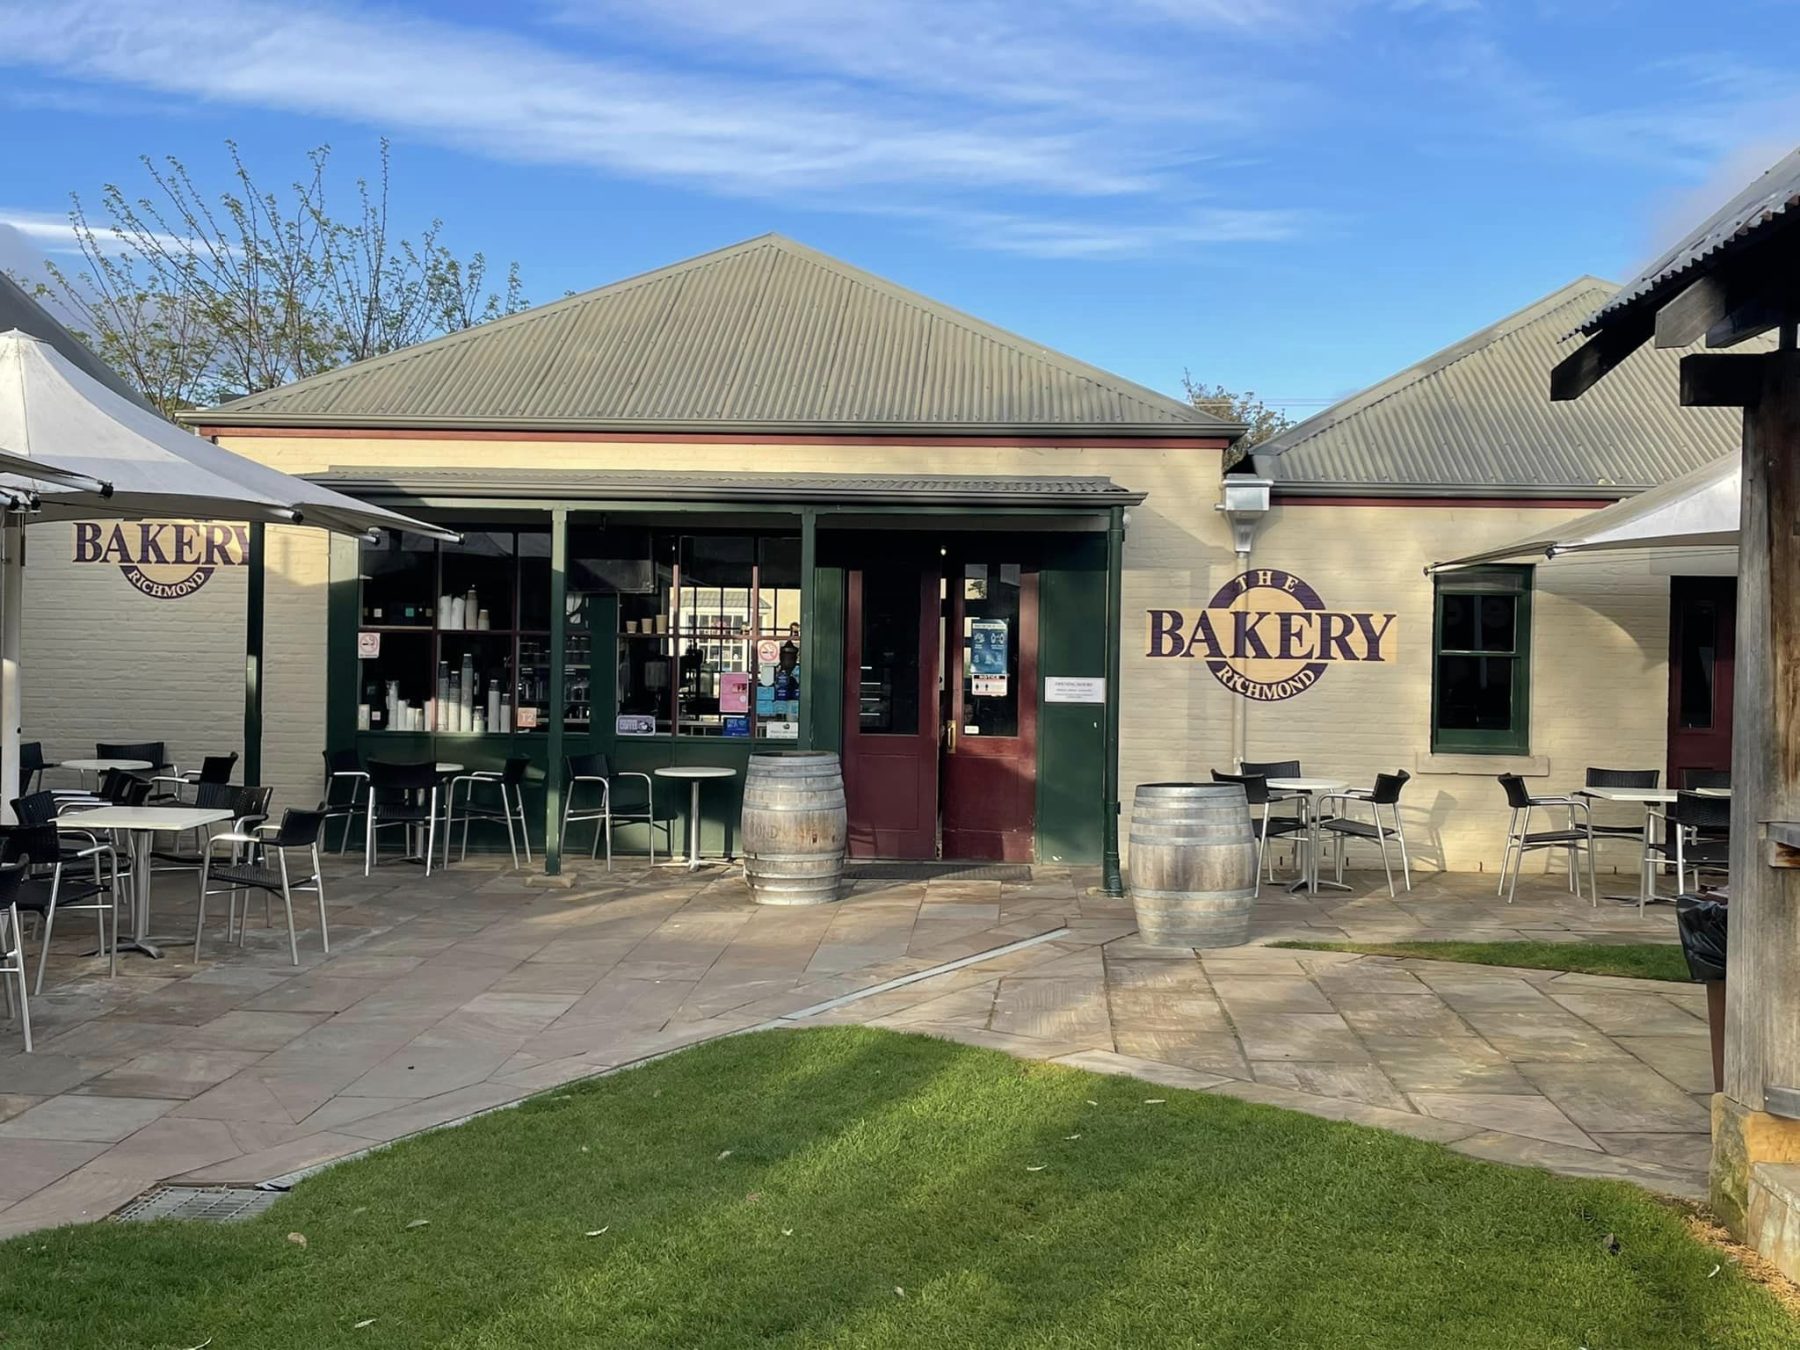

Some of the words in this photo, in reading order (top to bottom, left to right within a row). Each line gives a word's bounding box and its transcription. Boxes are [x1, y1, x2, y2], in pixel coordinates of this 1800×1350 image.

[128, 569, 205, 597] RICHMOND
[1235, 570, 1298, 592] THE
[1146, 609, 1397, 662] BAKERY
[1216, 665, 1315, 700] RICHMOND
